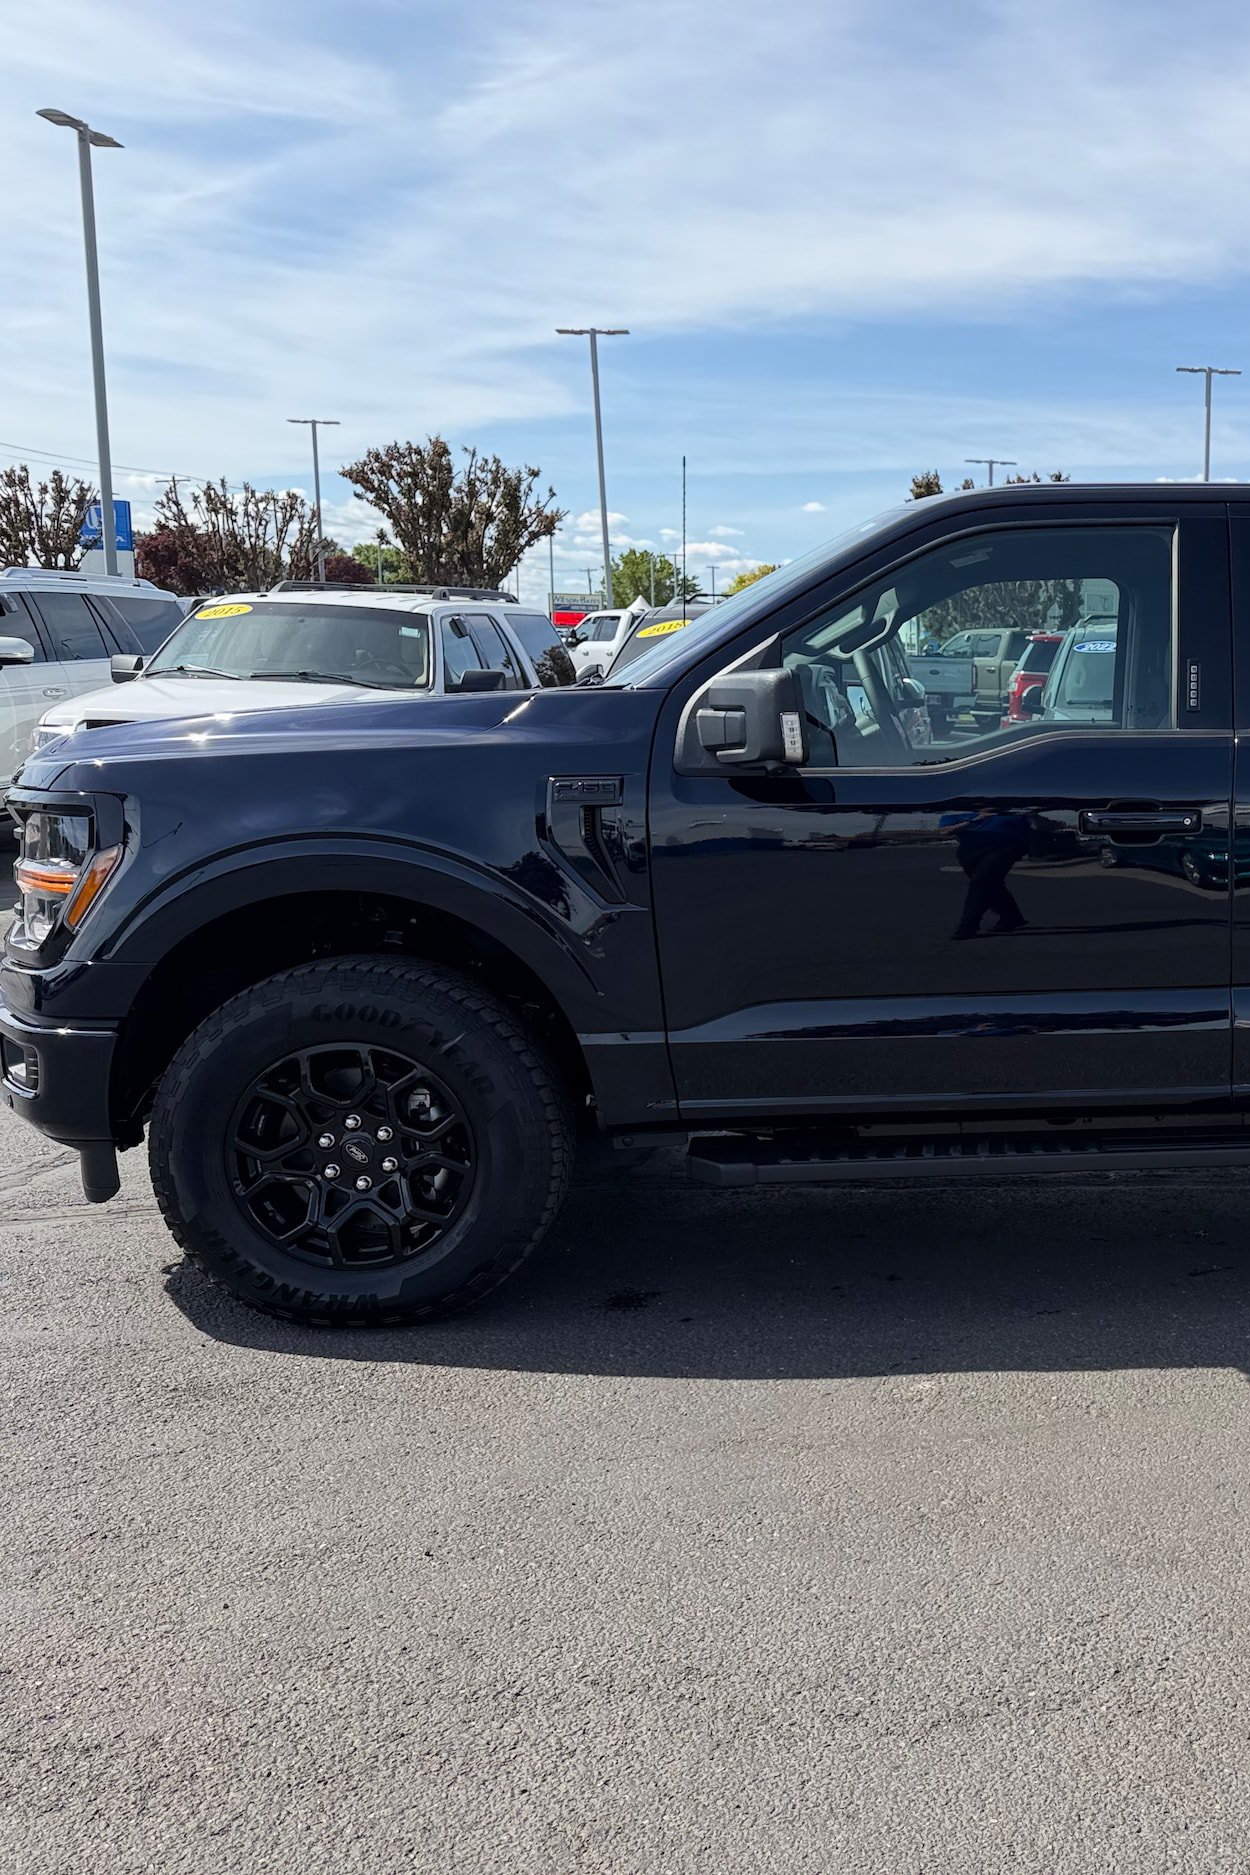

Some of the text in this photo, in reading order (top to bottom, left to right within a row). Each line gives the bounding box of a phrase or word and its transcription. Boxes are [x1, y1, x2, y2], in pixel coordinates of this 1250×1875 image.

[203, 606, 244, 618] 2015
[647, 621, 684, 636] 2018
[200, 1227, 381, 1311] WRANGLER
